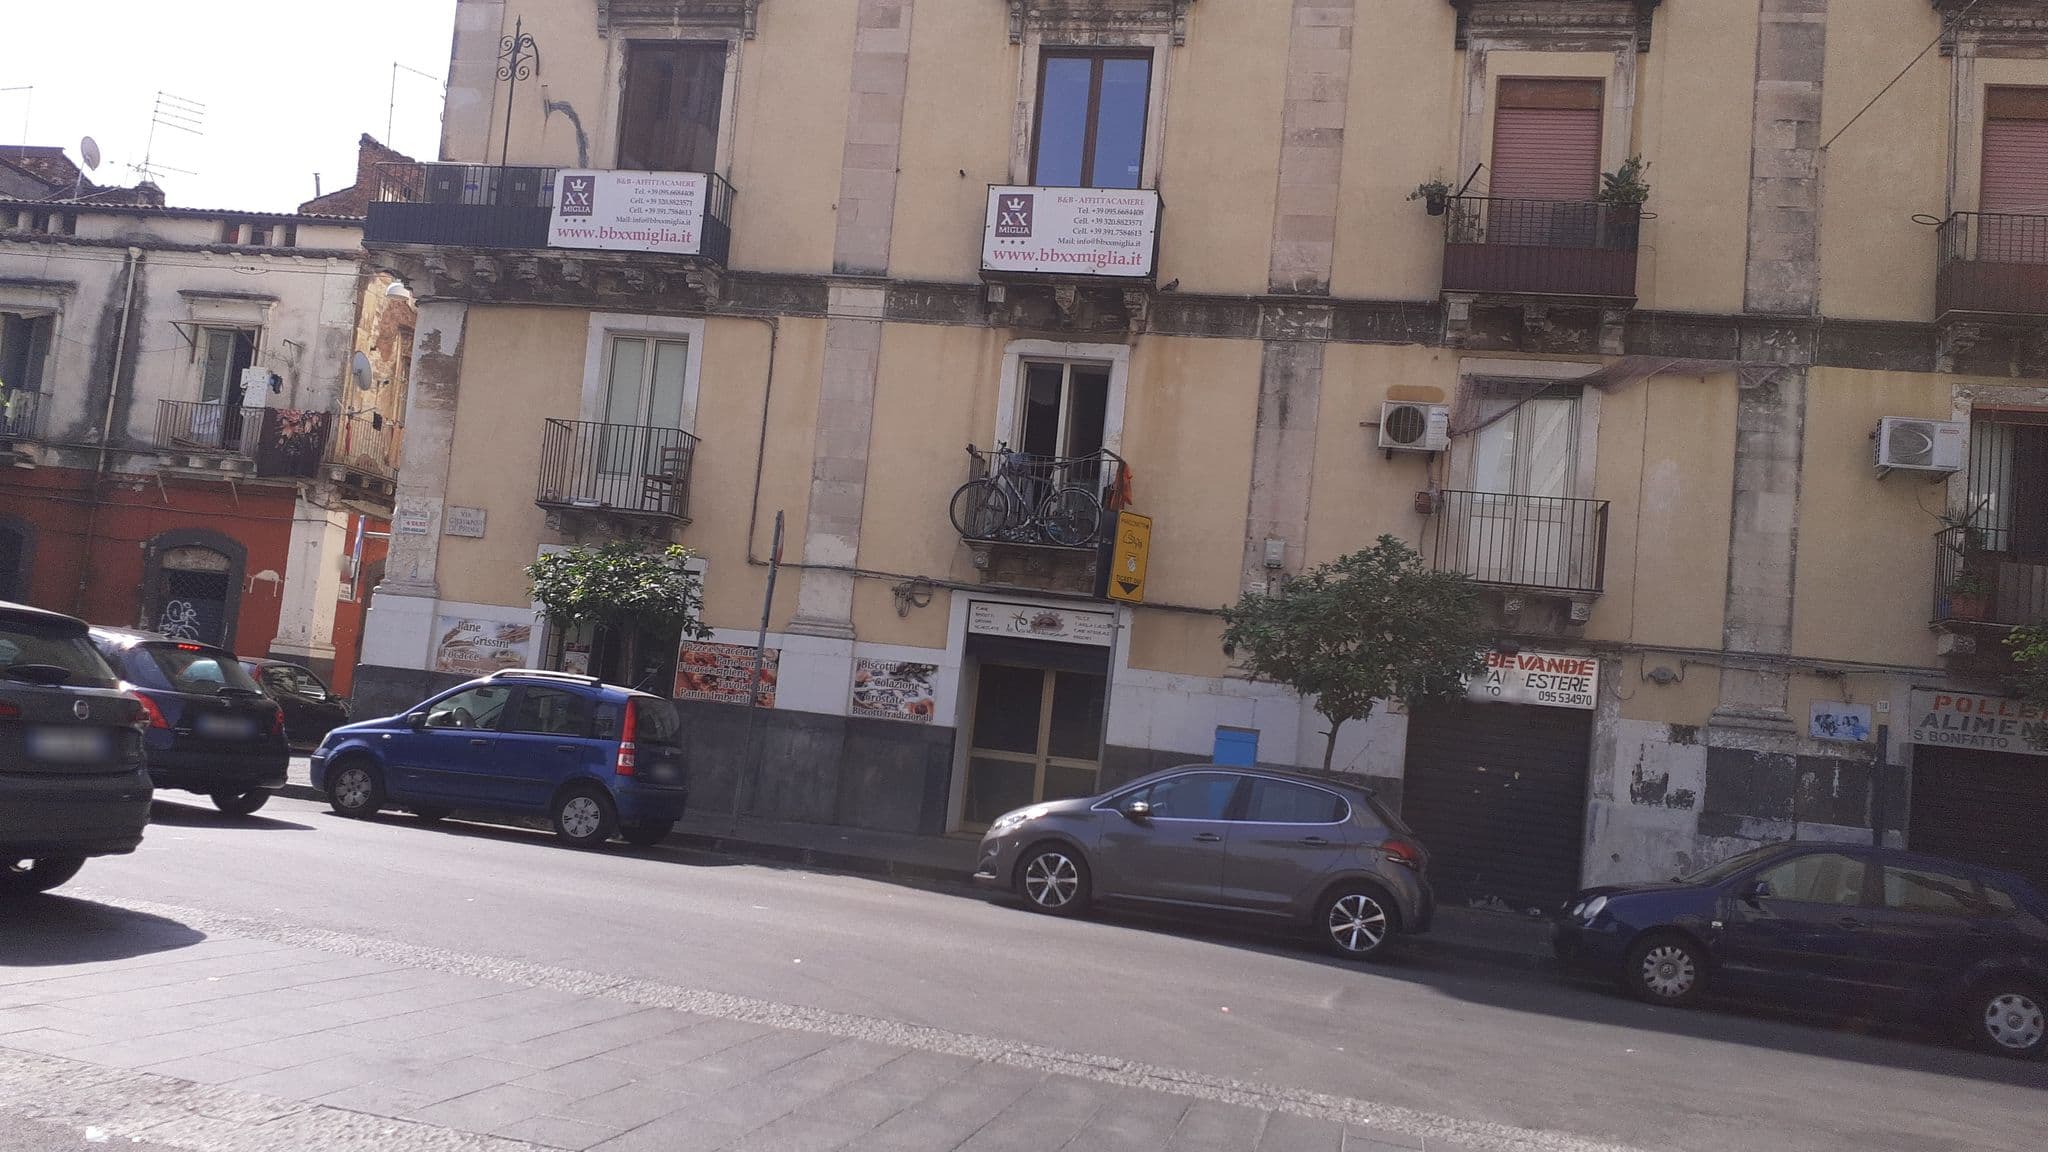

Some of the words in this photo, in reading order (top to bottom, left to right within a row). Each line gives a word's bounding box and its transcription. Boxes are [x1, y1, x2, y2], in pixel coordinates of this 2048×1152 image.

[1079, 197, 1144, 206] AFFITTACAMERE
[563, 205, 591, 214] MIGLIA
[557, 226, 692, 246] www.bbxxmiglia.it
[999, 226, 1030, 234] MIGLIA
[992, 248, 1143, 269] www.bbxxmiglia.it
[458, 621, 482, 633] Pane
[473, 636, 510, 649] Grissini
[861, 660, 896, 671] Biscotti
[1485, 652, 1595, 676] BEVANDE
[875, 678, 919, 690] Colazione
[1525, 673, 1591, 692] ESTERE
[1538, 690, 1556, 702] 095
[1558, 691, 1592, 705] 534970
[1914, 730, 1923, 740] S
[1929, 731, 2008, 747] BONFATTO
